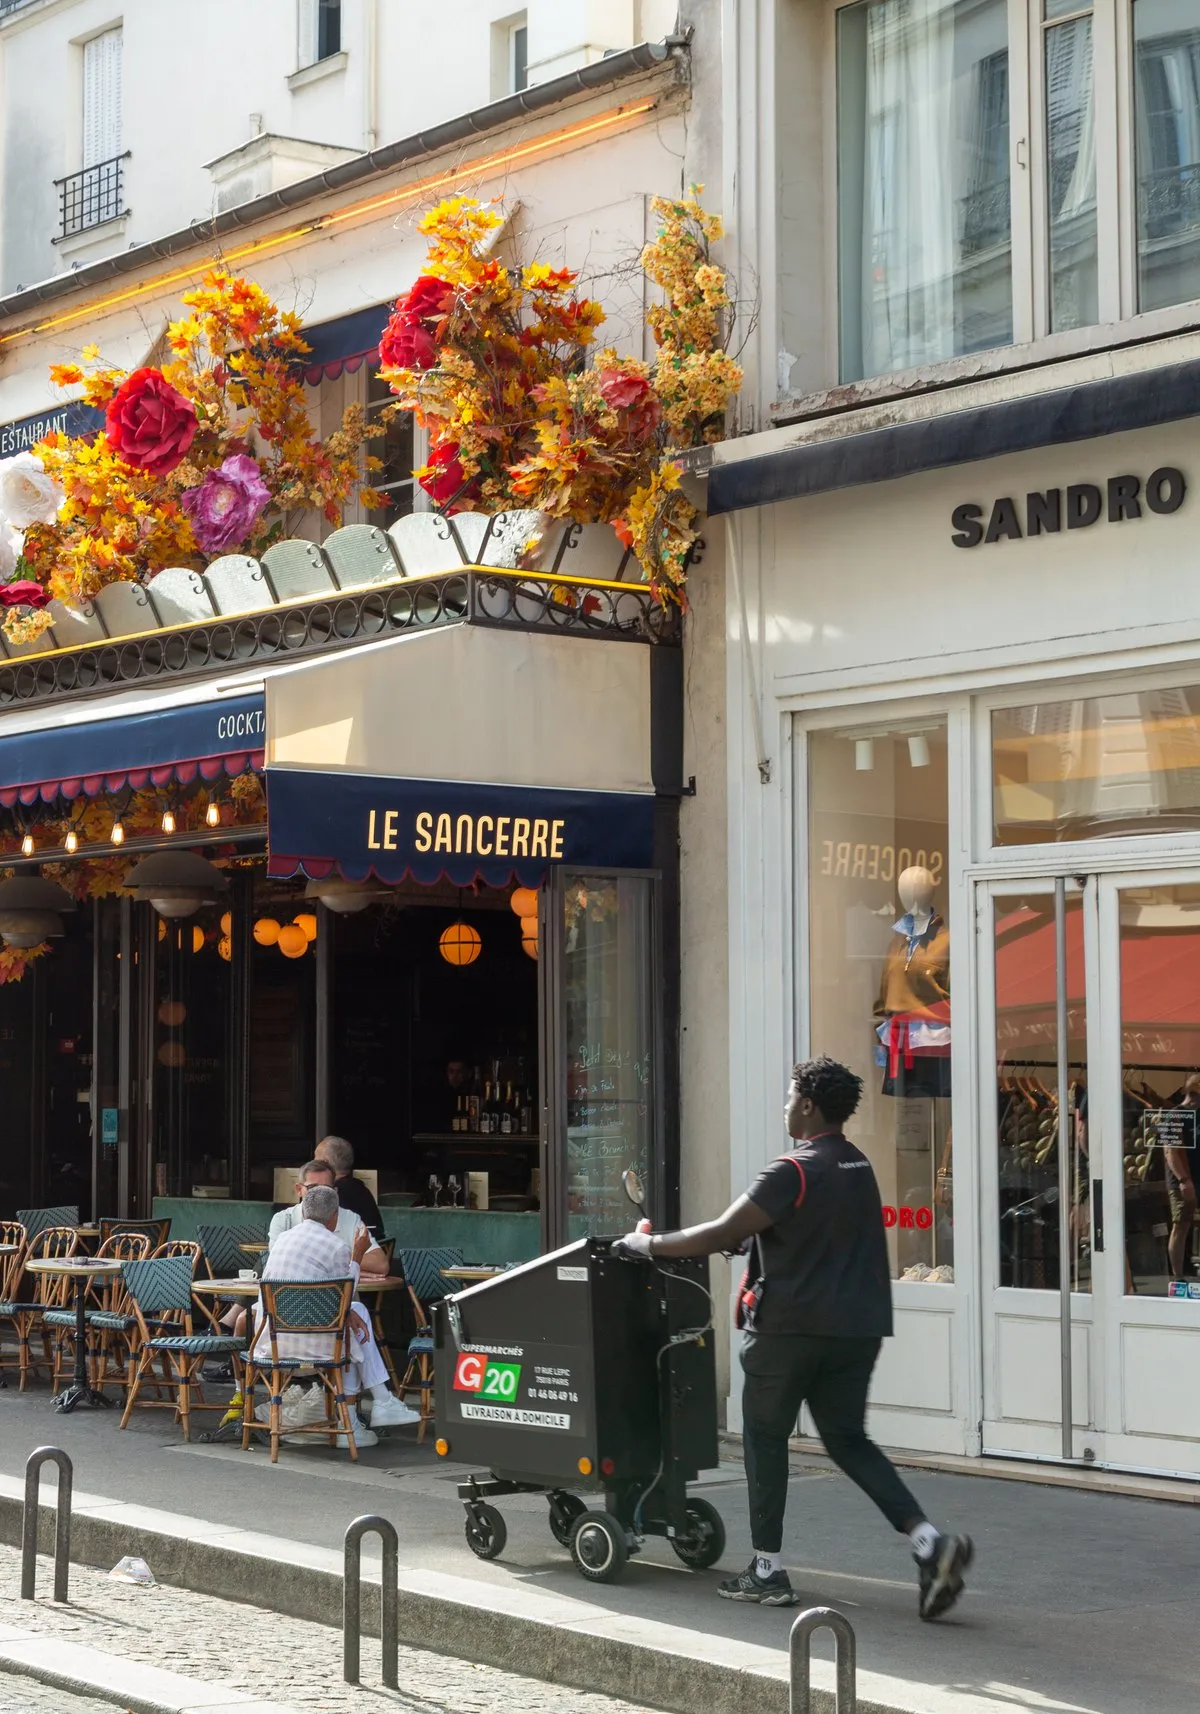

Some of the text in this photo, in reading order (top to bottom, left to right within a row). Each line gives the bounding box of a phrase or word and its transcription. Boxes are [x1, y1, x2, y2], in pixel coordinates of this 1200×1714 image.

[951, 466, 1187, 549] SANDRO
[368, 809, 566, 859] LE SANCERRE
[883, 1205, 933, 1231] DRO
[460, 1343, 524, 1357] SUPERMARCHÉS
[458, 1356, 516, 1396] G20
[541, 1366, 553, 1375] RUE
[553, 1367, 571, 1377] LEPIC
[552, 1377, 570, 1387] PARIS
[527, 1387, 537, 1398] 01
[537, 1388, 548, 1399] 46
[547, 1389, 558, 1401] 06
[568, 1392, 579, 1403] 16
[466, 1406, 512, 1421] LIVRAISON
[523, 1412, 566, 1427] DOMICILE
